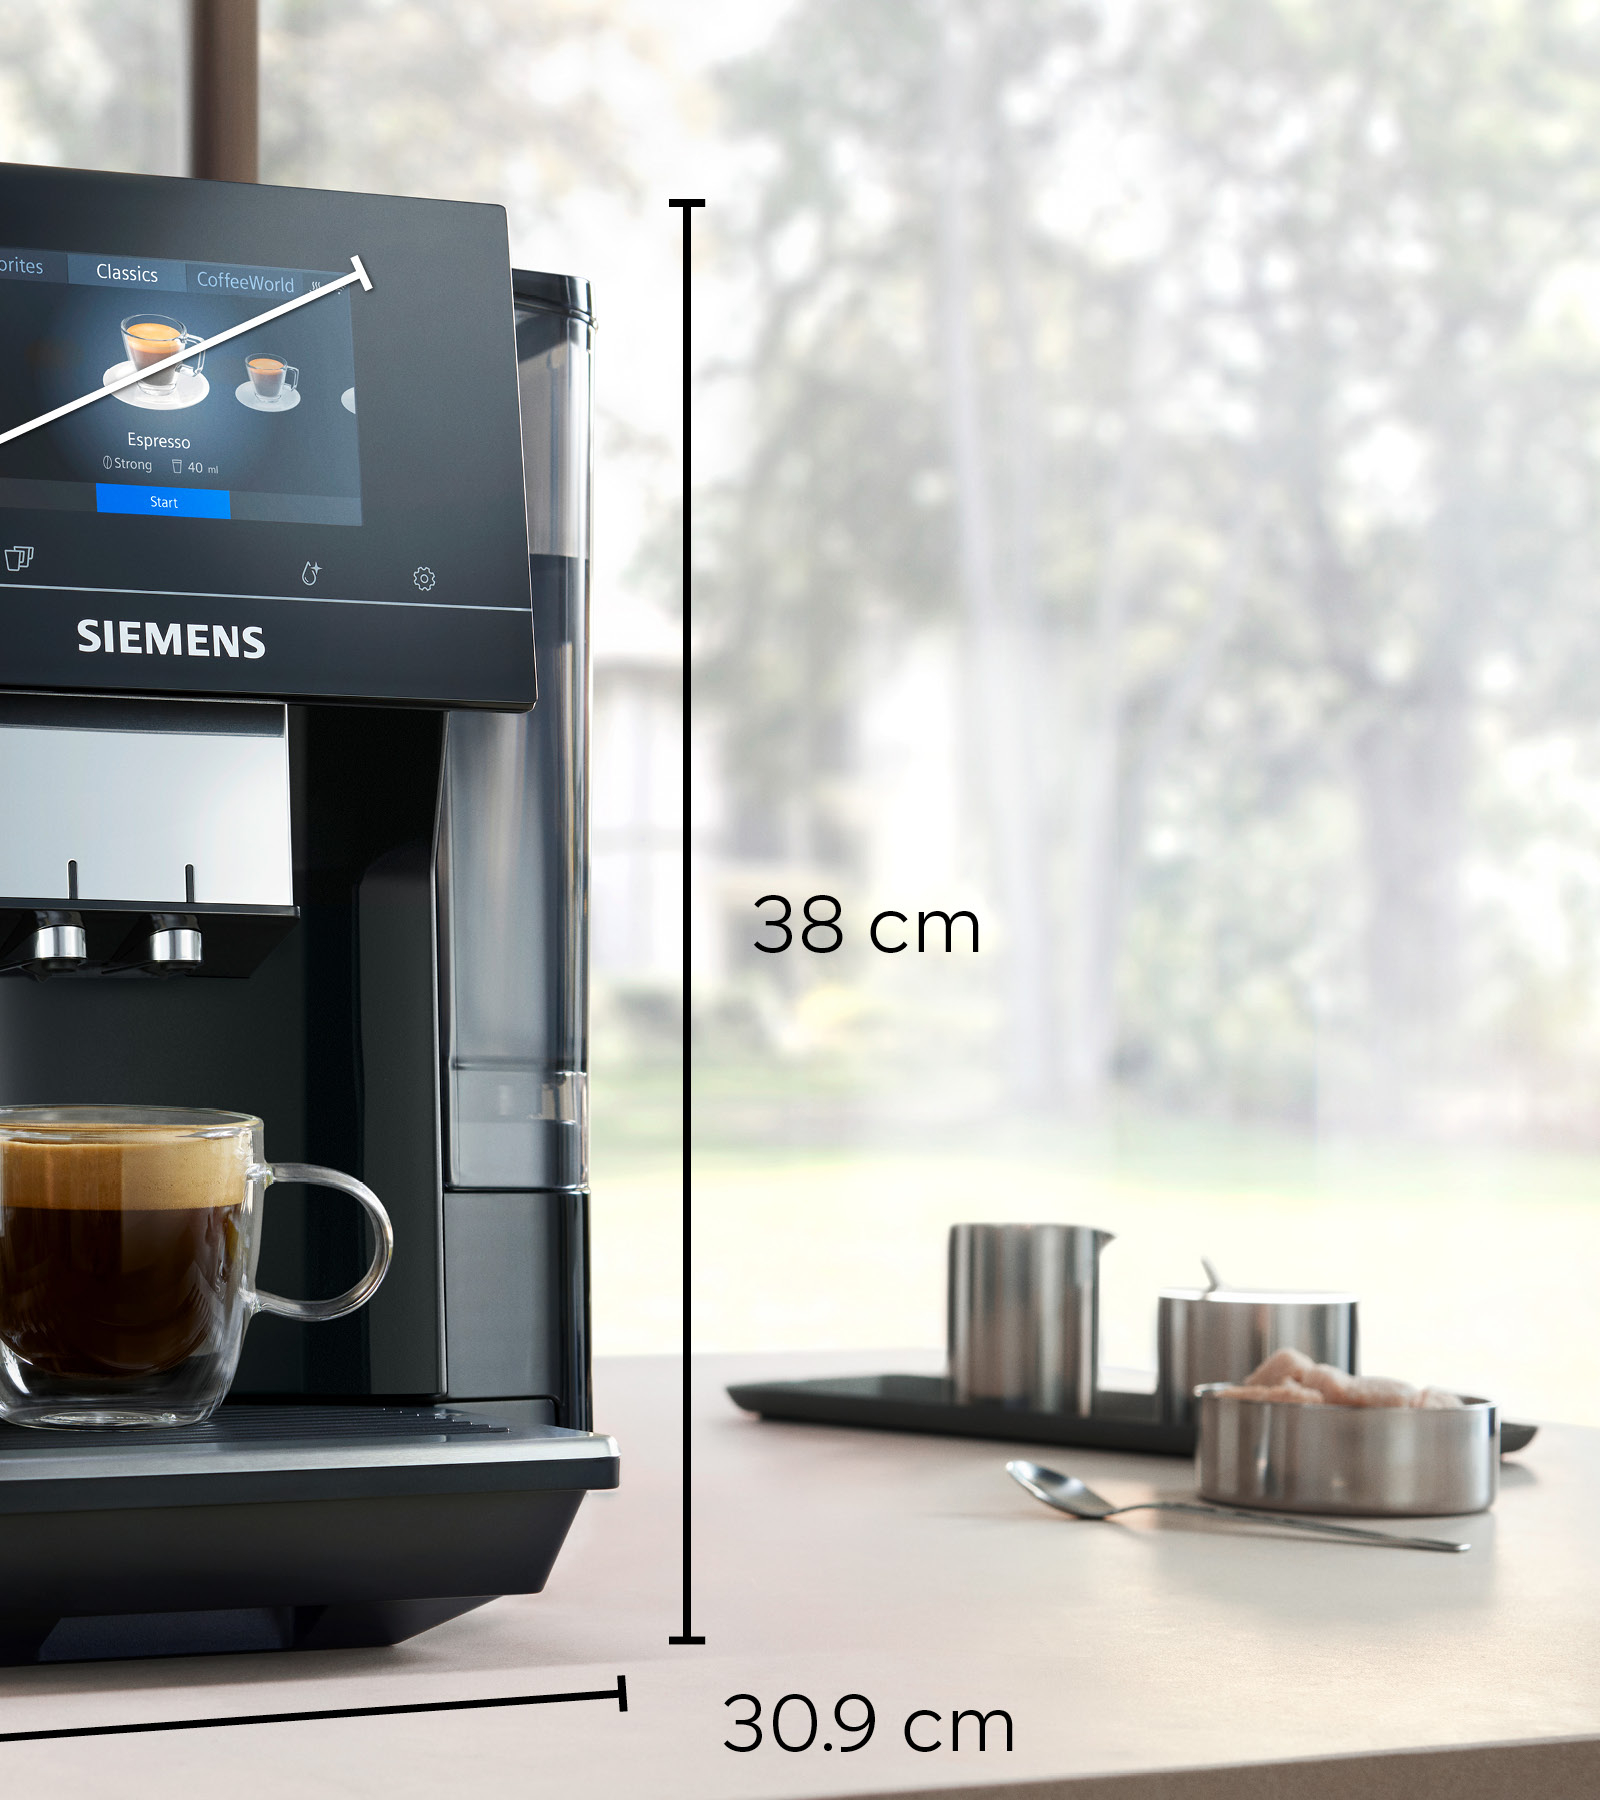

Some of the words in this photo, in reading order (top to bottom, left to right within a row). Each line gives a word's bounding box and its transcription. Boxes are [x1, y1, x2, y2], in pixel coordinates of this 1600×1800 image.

[96, 263, 159, 284] Classics
[197, 271, 295, 294] CoffeeWorld
[127, 431, 191, 450] Espresso
[114, 457, 153, 473] Strong
[187, 461, 203, 474] 40
[207, 464, 219, 474] ml
[150, 495, 179, 510] Start
[77, 618, 267, 660] SIEMENS
